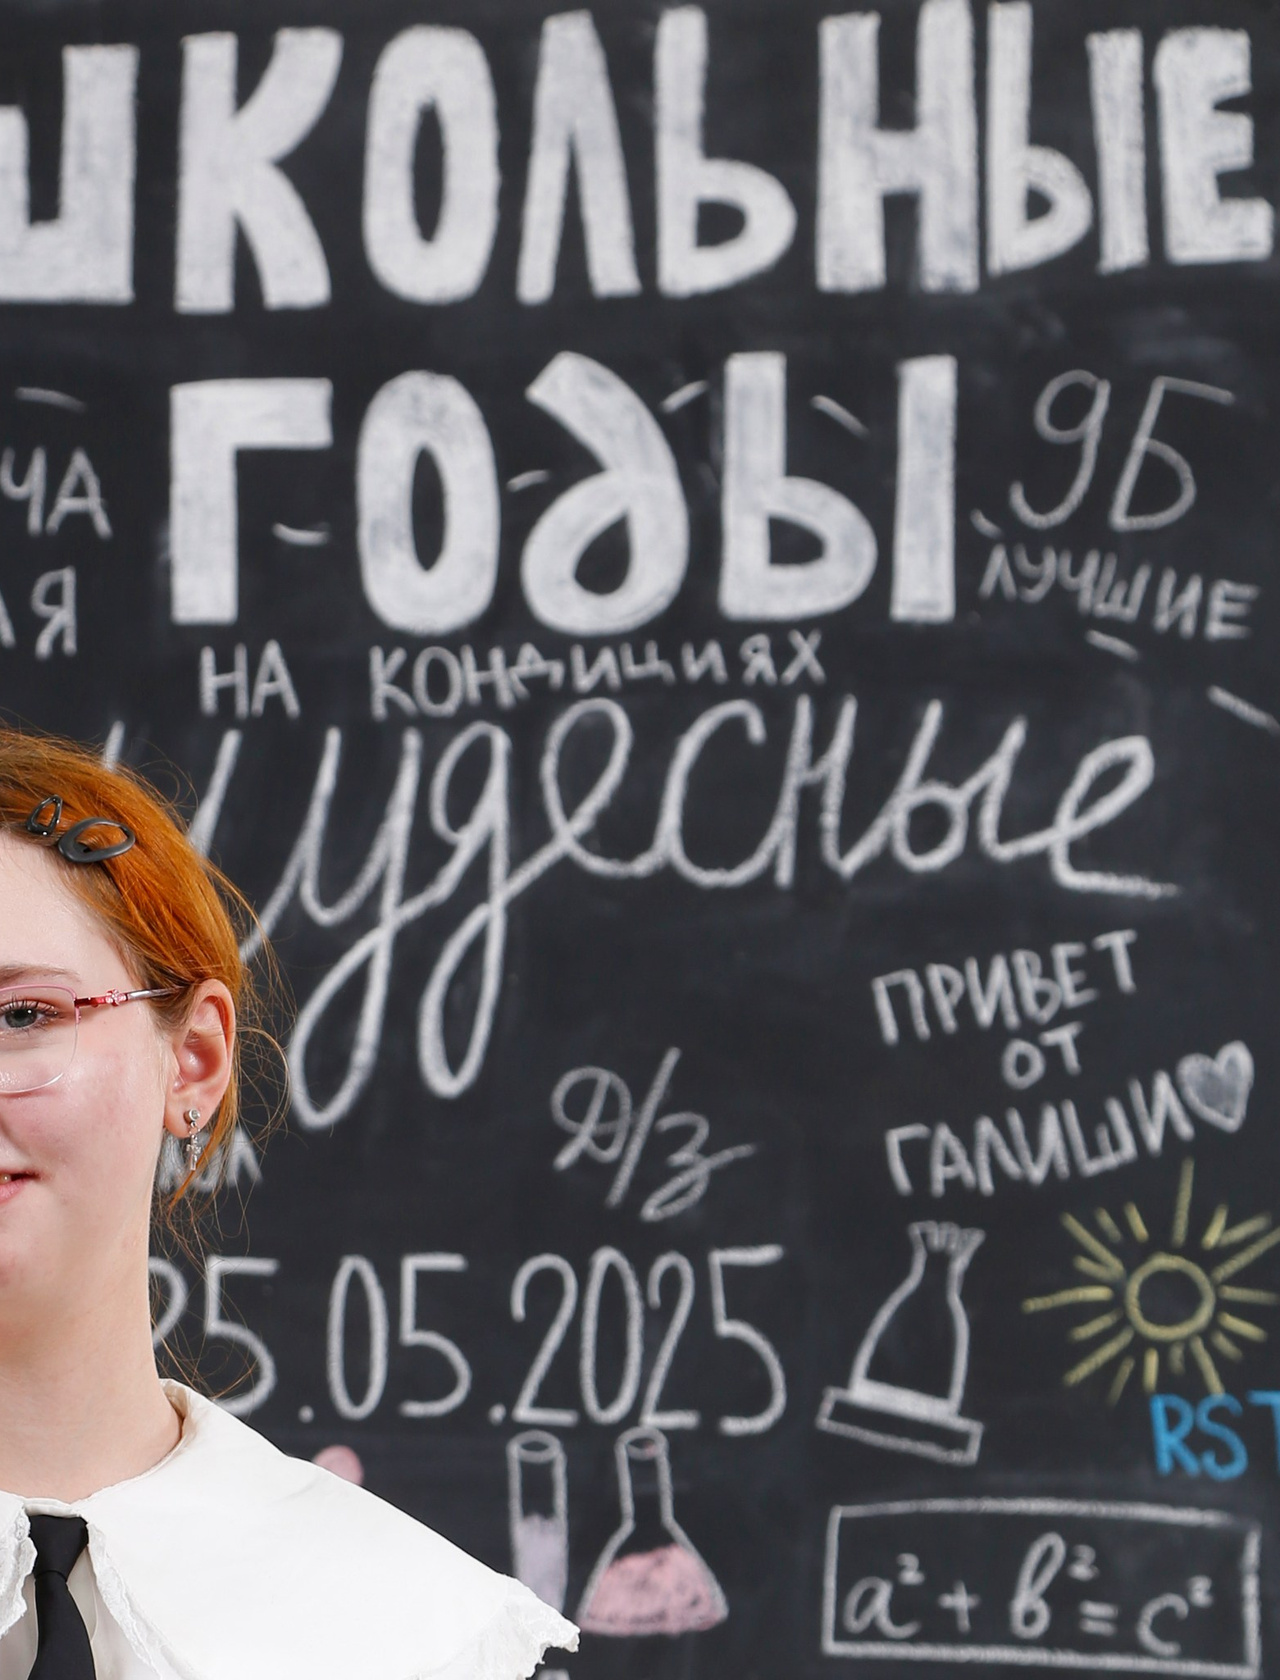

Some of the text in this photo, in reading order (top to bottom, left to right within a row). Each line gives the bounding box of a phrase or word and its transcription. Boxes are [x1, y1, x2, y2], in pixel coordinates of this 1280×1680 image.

[169, 351, 956, 636] ГОДЫ
[1010, 369, 1234, 530] 9Б
[979, 543, 1258, 640] ЛУЧШИЕ
[200, 630, 826, 722] НА КОНДИЦИЯХ
[872, 929, 1138, 1046] ПРИВЕТ
[1001, 1021, 1084, 1090] ОТ
[885, 1069, 1195, 1196] ГАЛИШИ
